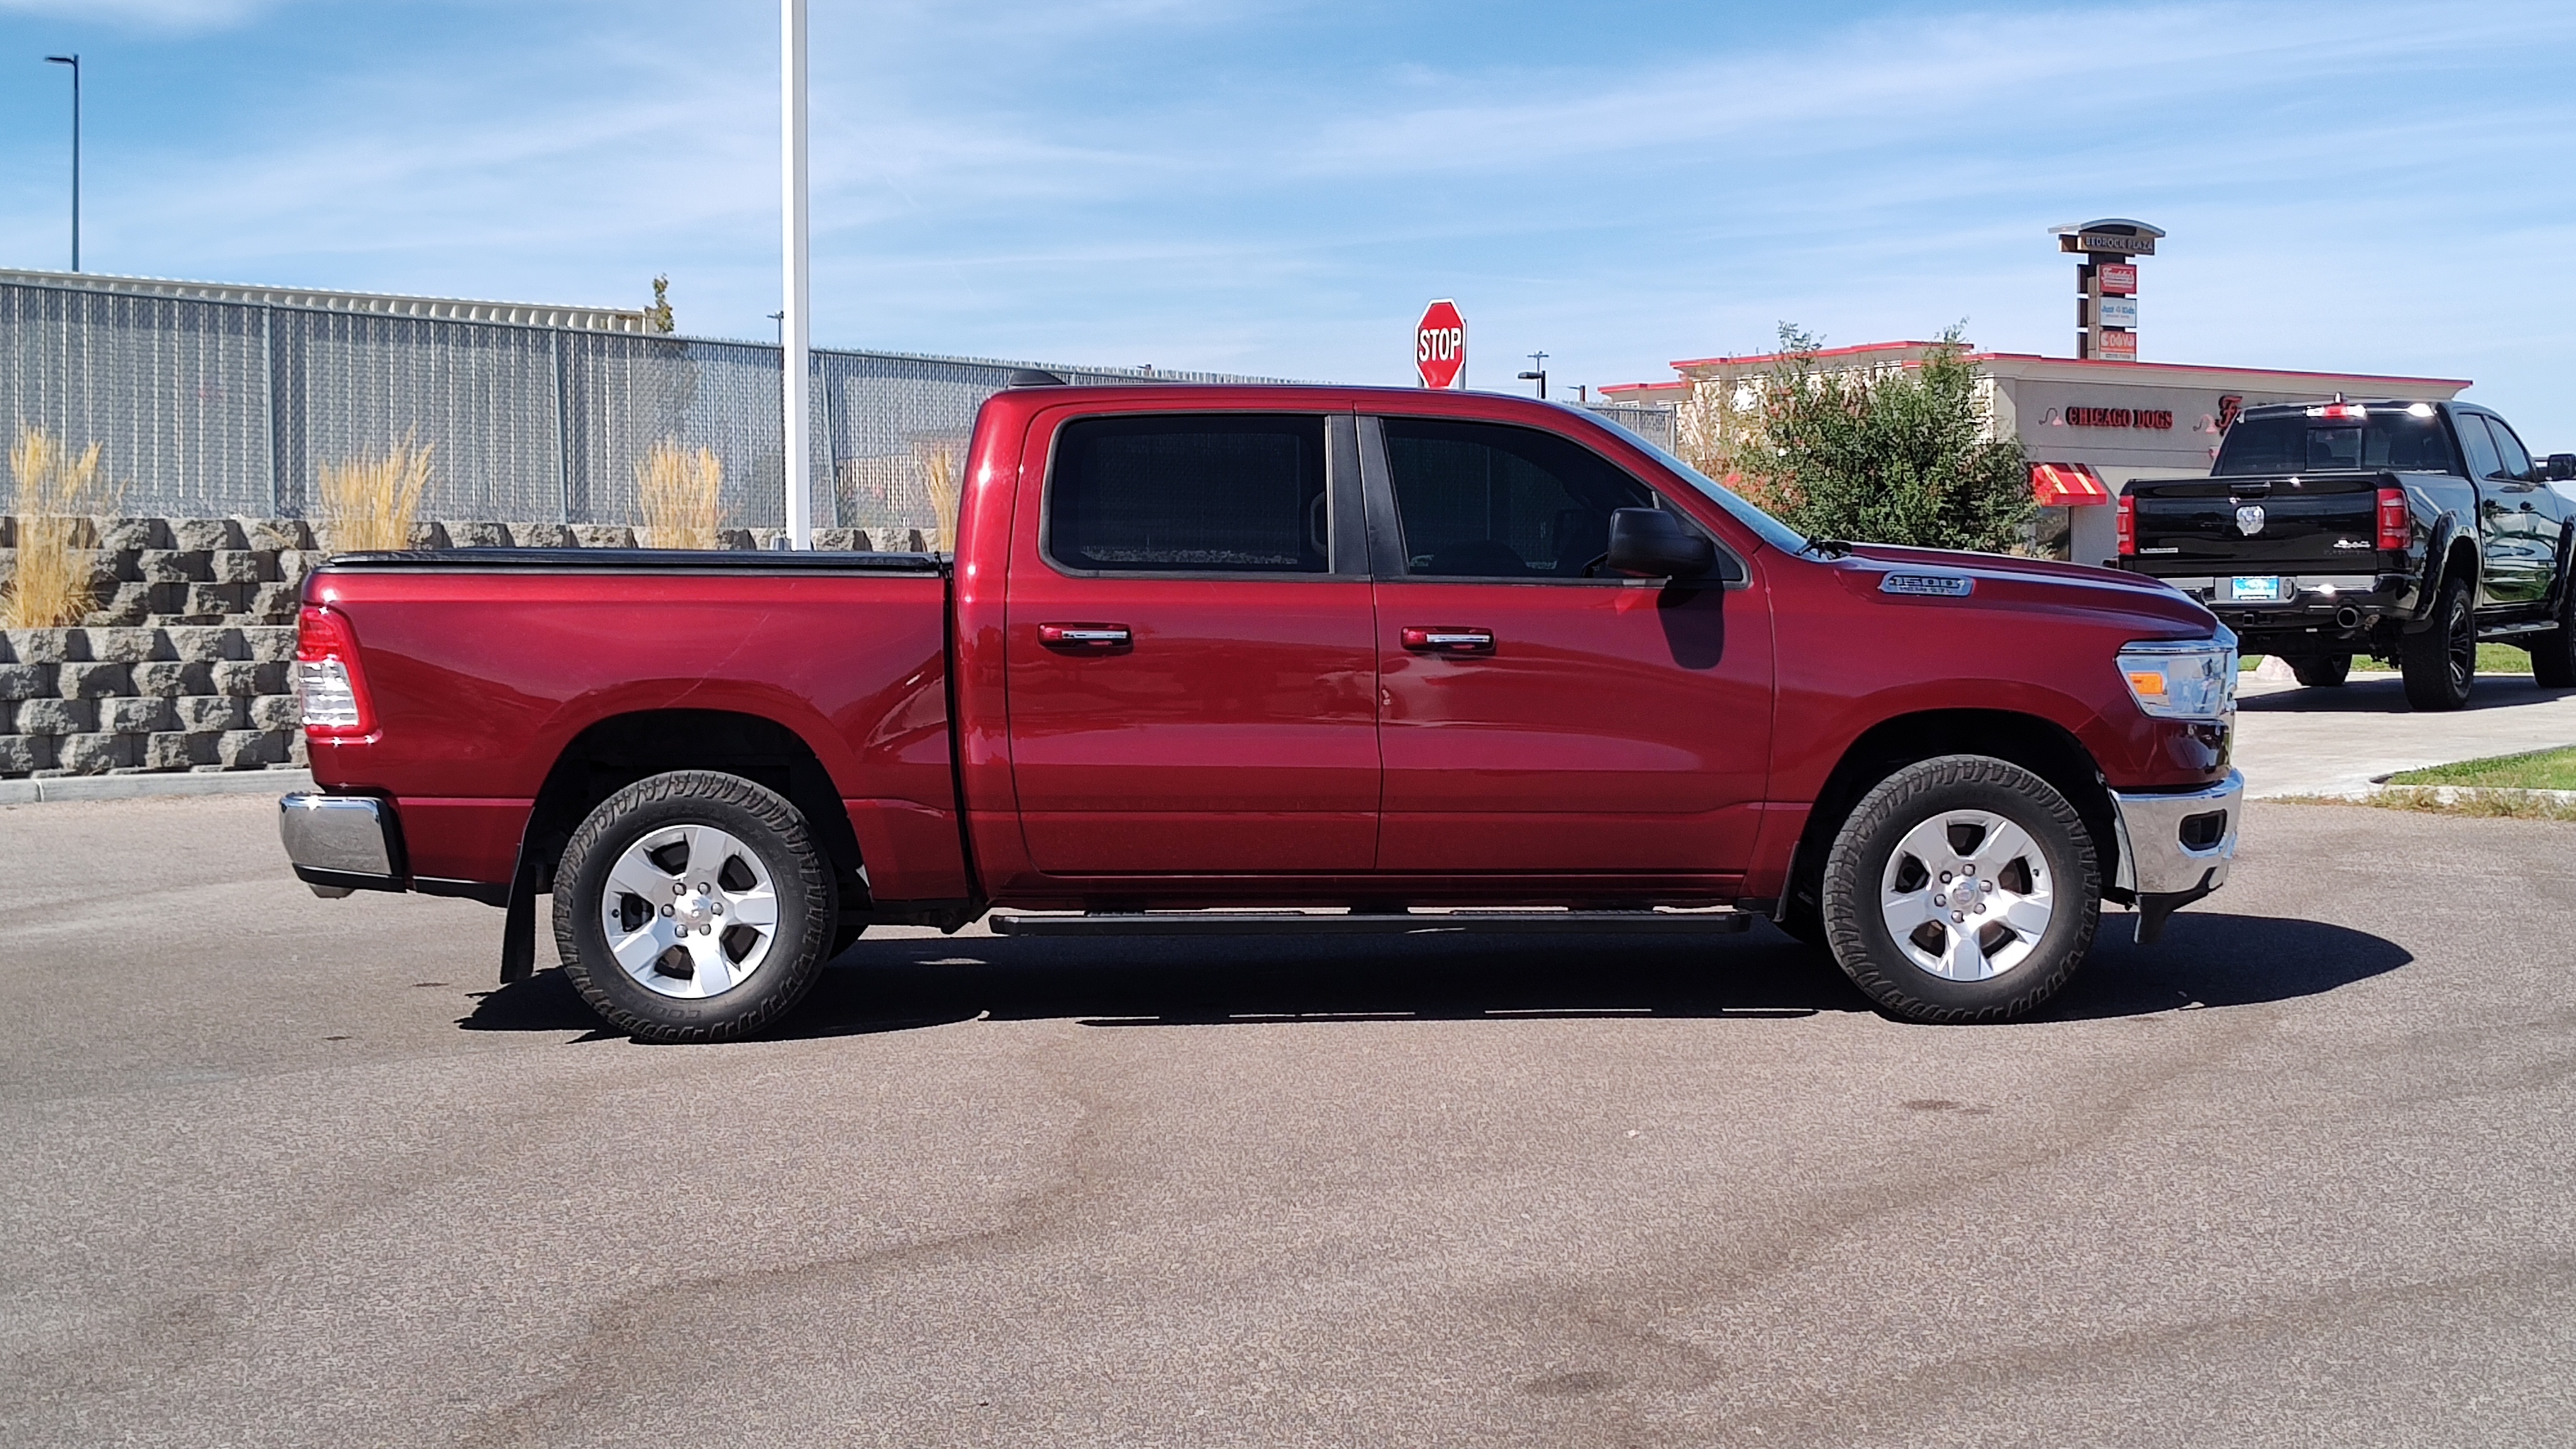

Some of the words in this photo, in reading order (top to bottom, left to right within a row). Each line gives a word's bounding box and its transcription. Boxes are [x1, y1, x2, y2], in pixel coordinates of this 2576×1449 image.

[2085, 236, 2125, 248] BEDROCK
[2128, 238, 2153, 250] PLAZA
[1418, 328, 1462, 362] STOP
[2067, 406, 2132, 427] CHICAGO
[2133, 409, 2174, 430] DOGS
